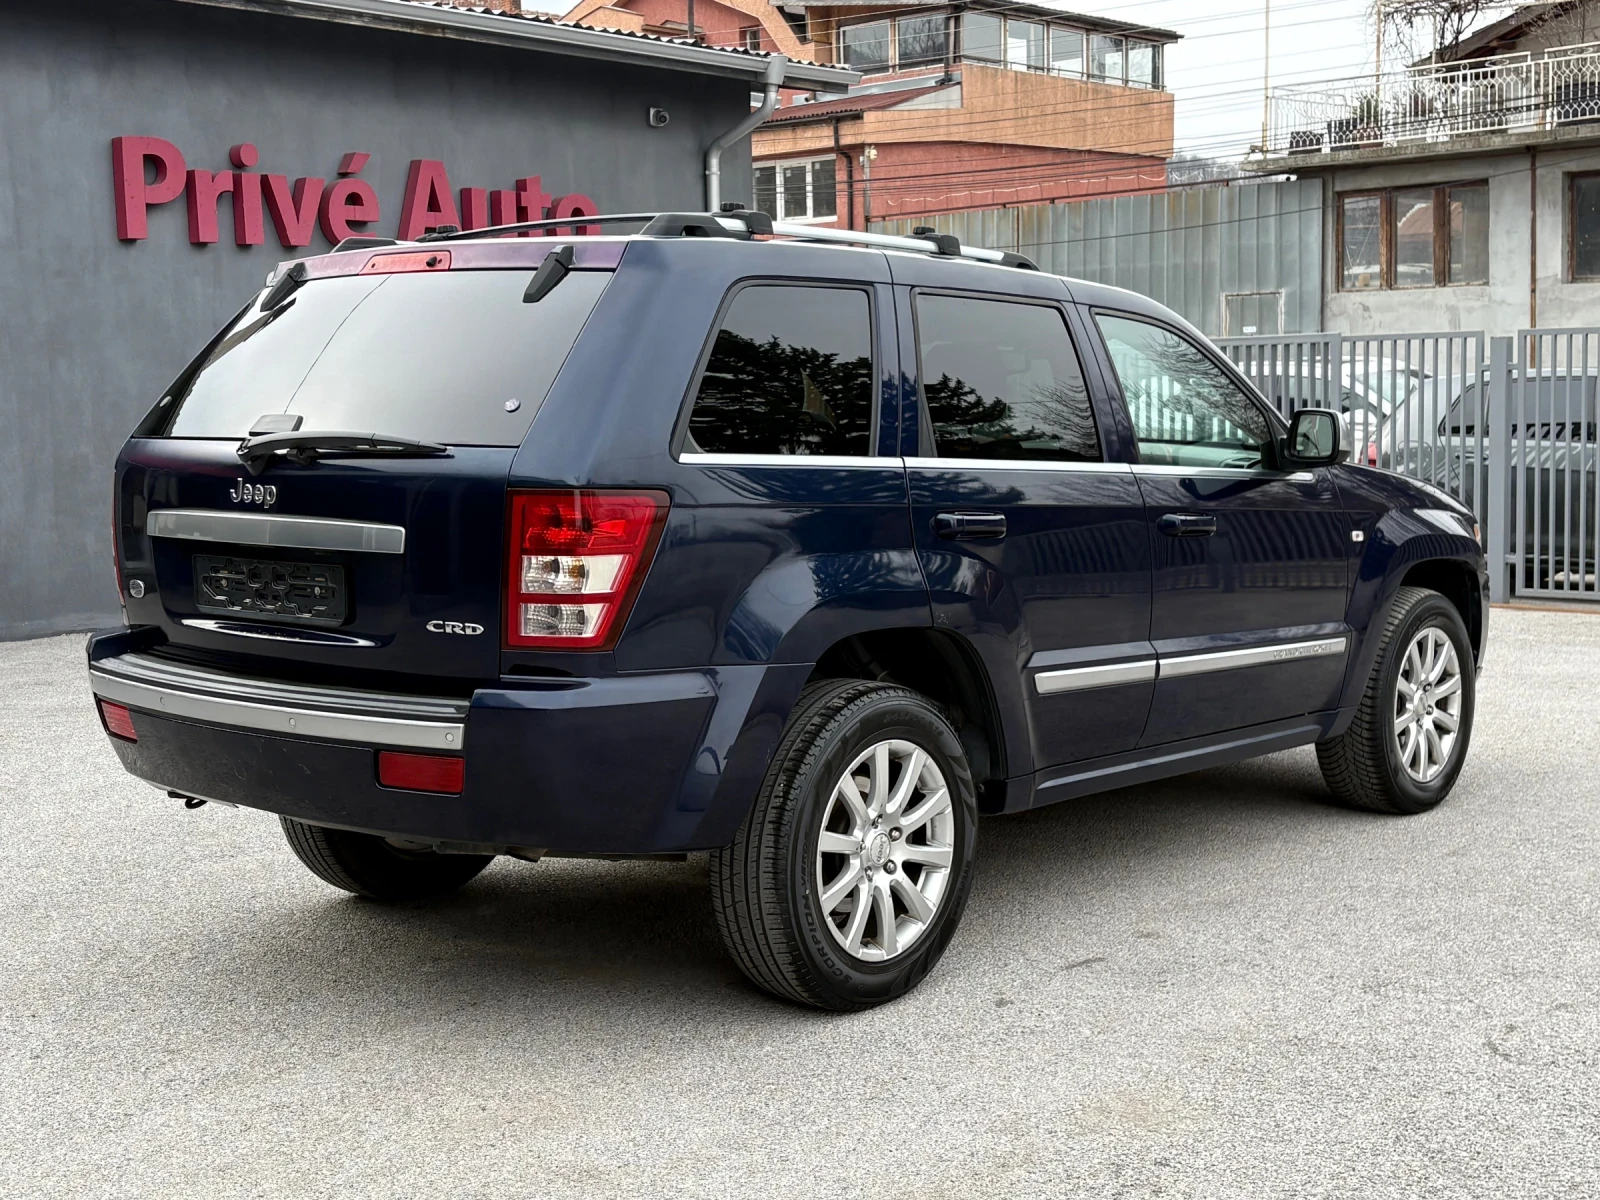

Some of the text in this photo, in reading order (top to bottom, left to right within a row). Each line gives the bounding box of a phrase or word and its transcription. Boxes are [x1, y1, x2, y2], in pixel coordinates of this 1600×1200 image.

[112, 135, 602, 248] Privé Auto
[230, 477, 277, 509] Jeep
[426, 620, 485, 635] CRD
